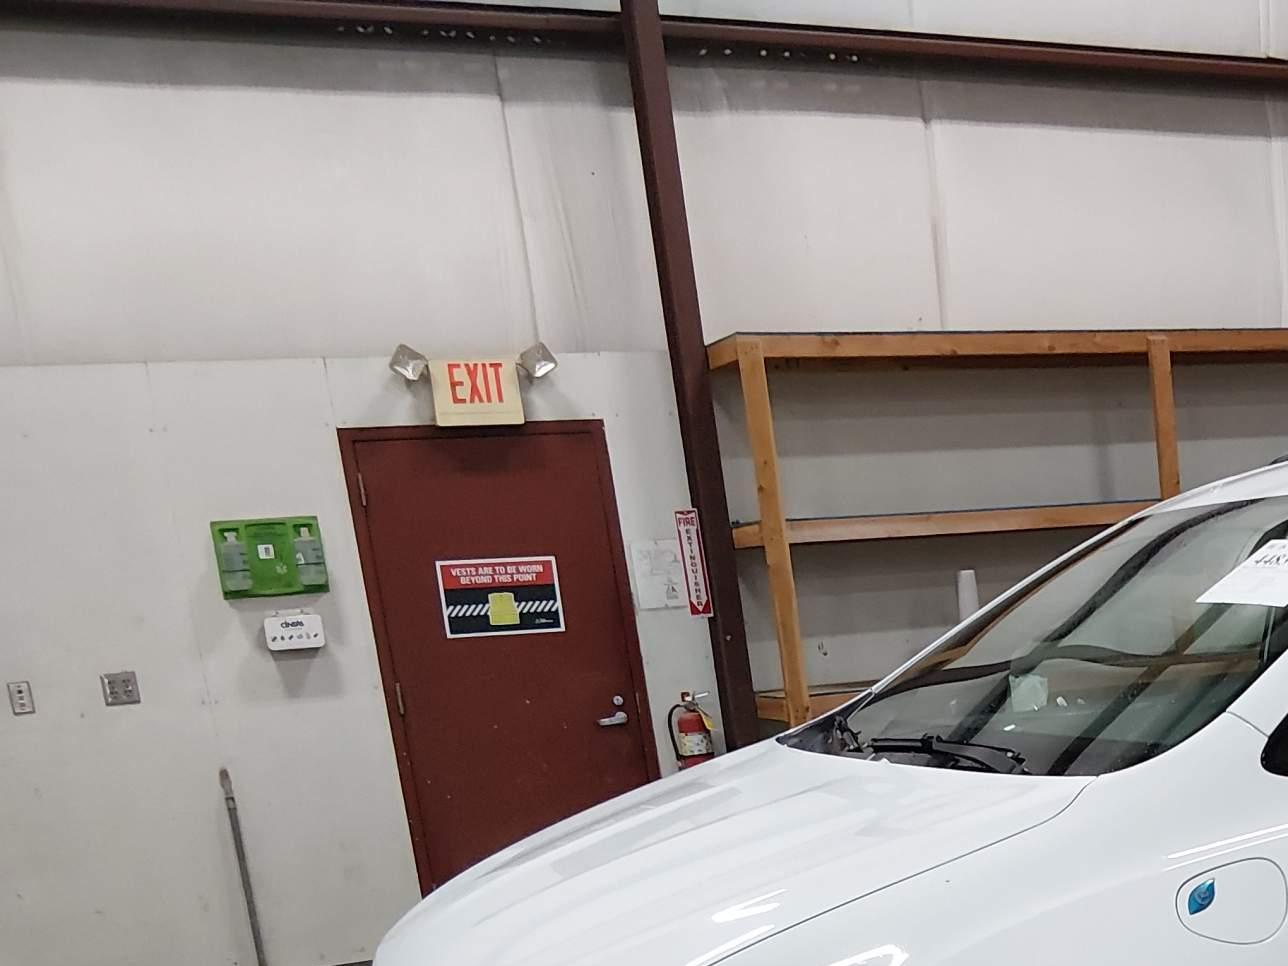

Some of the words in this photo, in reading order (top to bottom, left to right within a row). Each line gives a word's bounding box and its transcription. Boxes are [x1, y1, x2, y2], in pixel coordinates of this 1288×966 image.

[447, 362, 504, 404] EXIT
[677, 516, 696, 527] FIRE
[450, 567, 476, 577] VESTS
[478, 566, 494, 575] ARE
[495, 565, 506, 575] TO
[507, 565, 518, 574] BE
[518, 564, 544, 573] WORN
[685, 528, 704, 607] EXTINGUISHER
[460, 575, 493, 585] BEYOND
[494, 574, 512, 583] THIS
[513, 573, 537, 582] POINT
